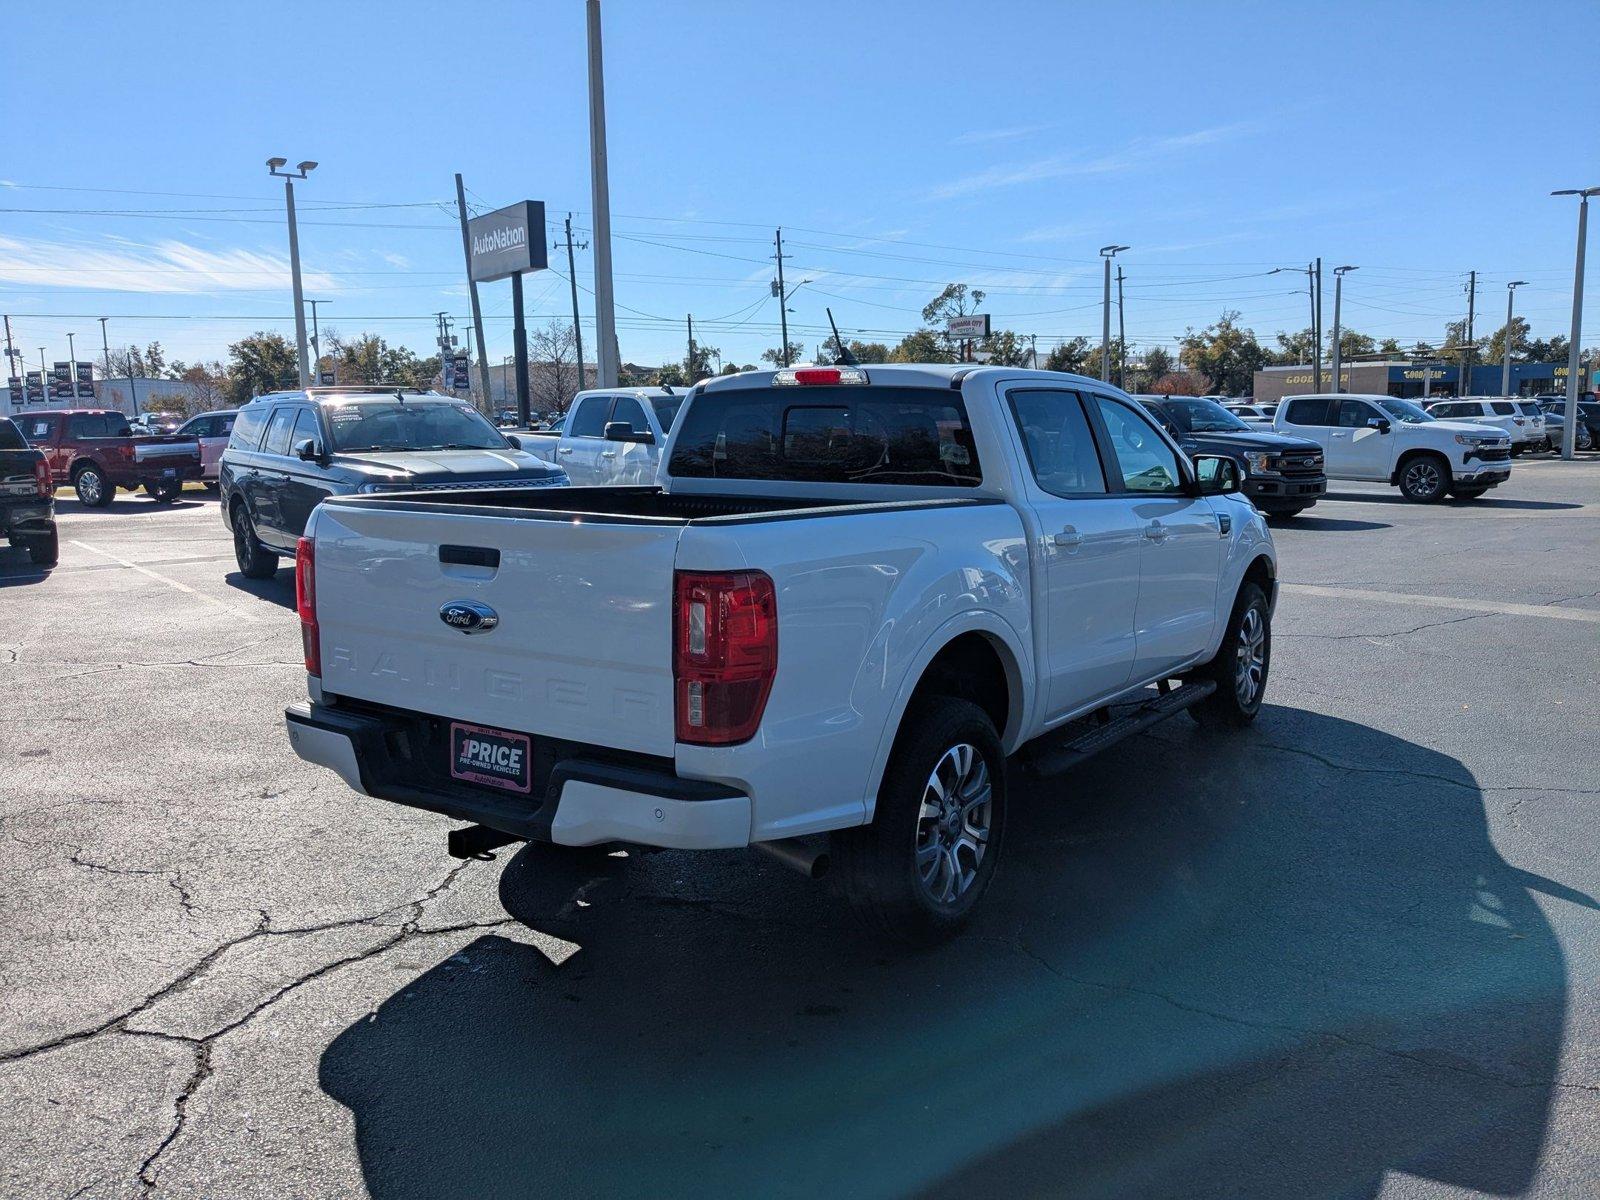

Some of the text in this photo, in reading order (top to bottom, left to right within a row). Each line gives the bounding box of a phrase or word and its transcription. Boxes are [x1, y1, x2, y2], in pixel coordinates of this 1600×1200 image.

[473, 226, 525, 257] AutoNation
[1404, 370, 1443, 381] GOODEAR
[446, 609, 472, 625] Ford
[328, 646, 661, 722] RANGER
[459, 756, 521, 776] PRE-OWNED VEHICLES
